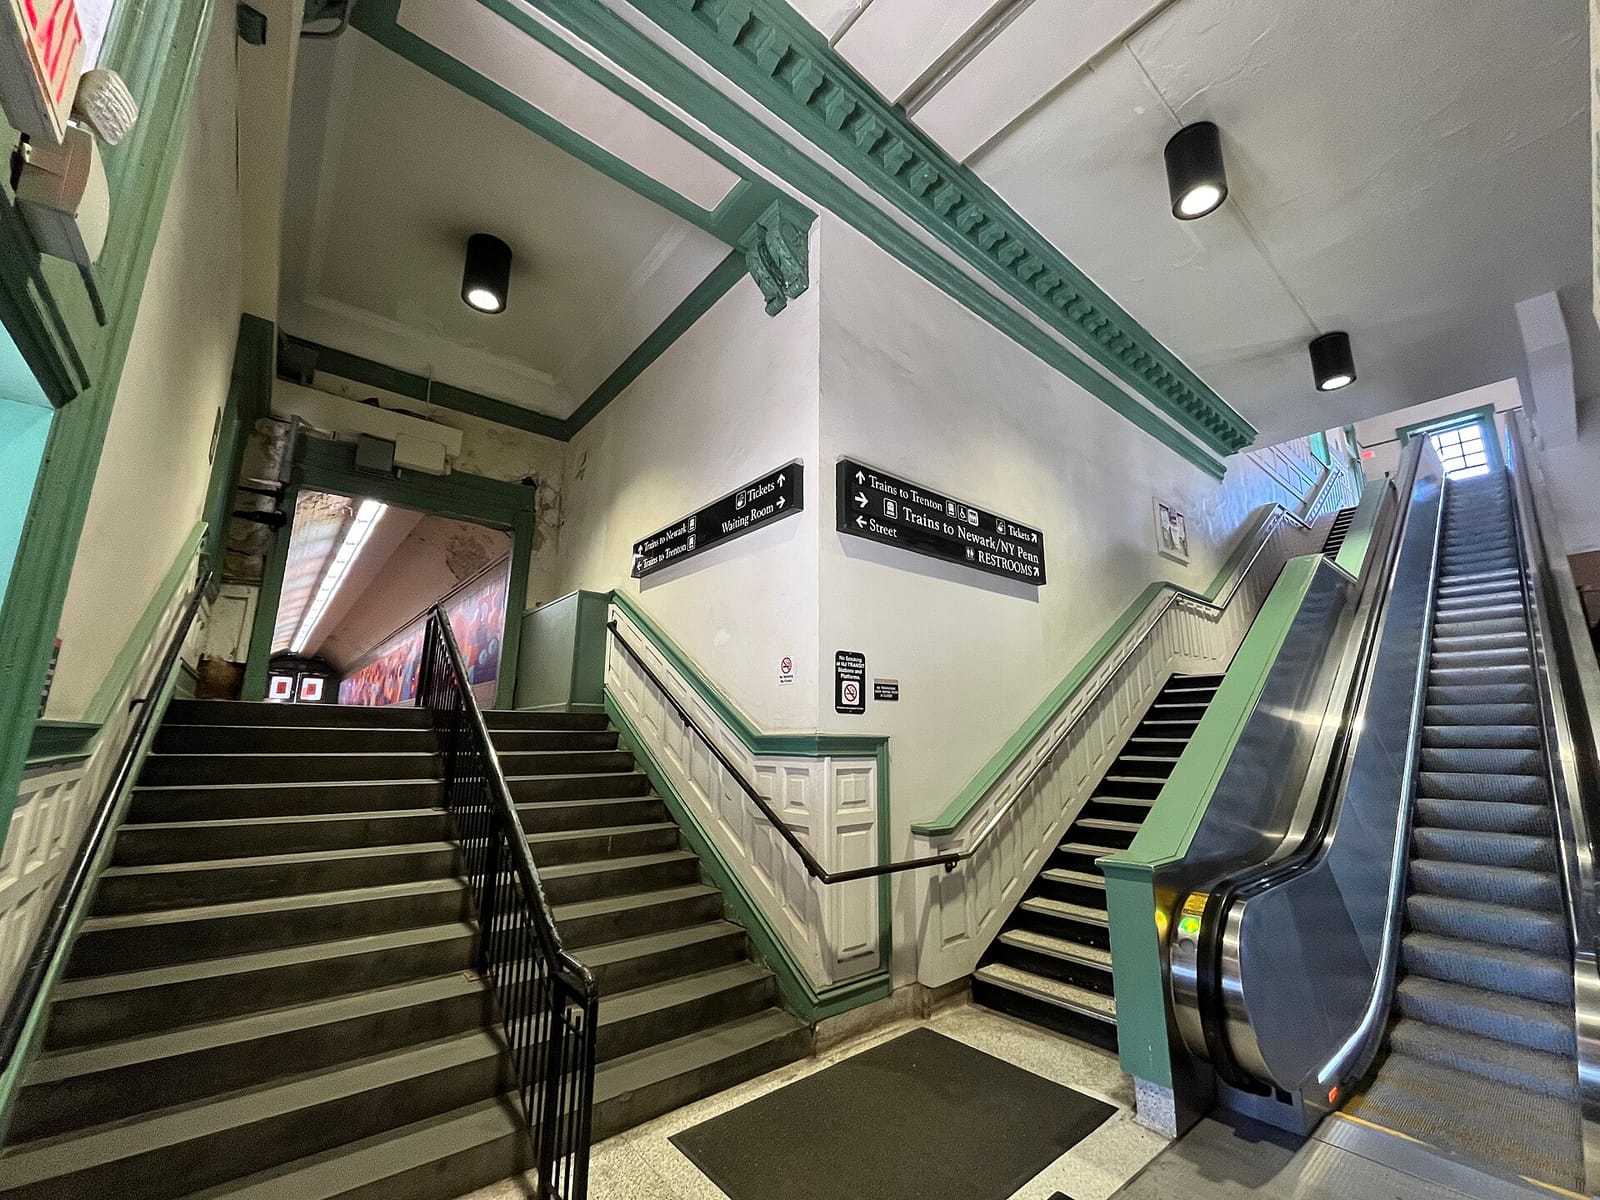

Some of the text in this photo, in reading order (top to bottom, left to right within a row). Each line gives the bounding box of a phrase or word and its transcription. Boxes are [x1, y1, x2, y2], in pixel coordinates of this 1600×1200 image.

[747, 480, 775, 503] Tickets
[868, 474, 943, 512] Trains to Trenton
[721, 504, 774, 534] Waiting Room
[869, 518, 898, 538] Street
[643, 523, 687, 552] Trains to Newark
[902, 506, 1040, 564] Trains to Newark/NY Penn
[1007, 524, 1030, 542] Tickets
[643, 544, 687, 568] Trains to Trenton
[977, 550, 1033, 577] RESTROOMS
